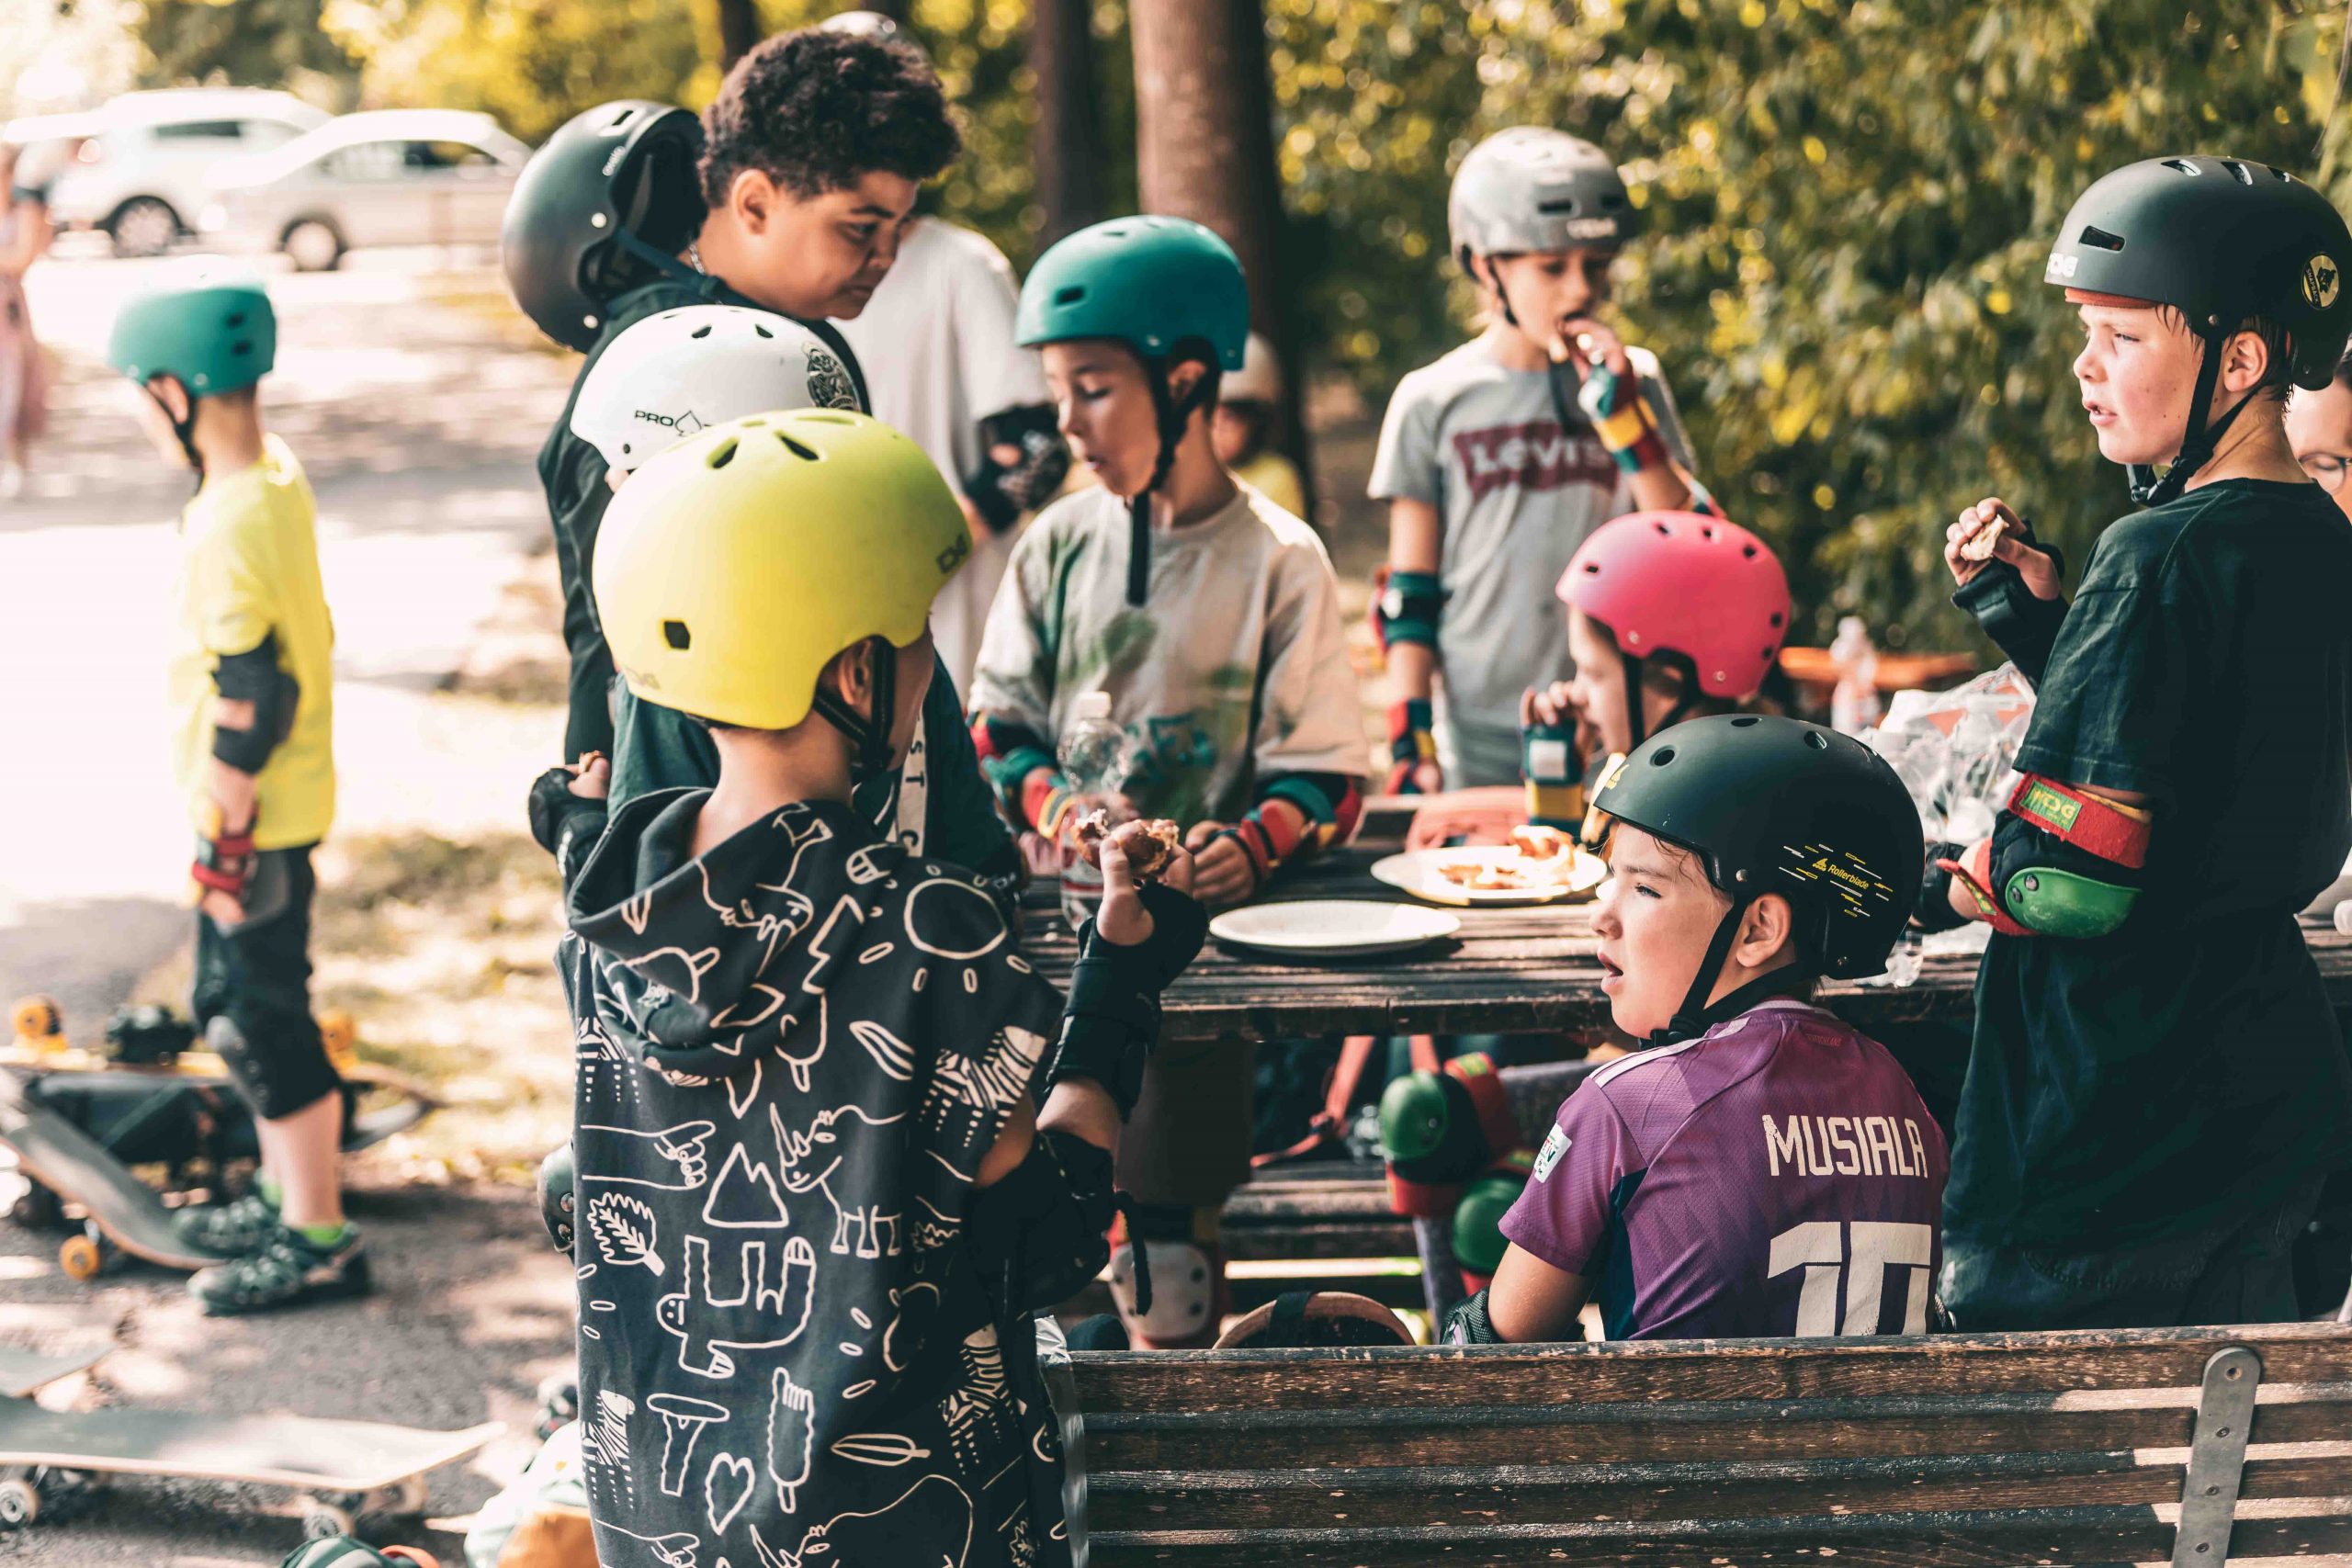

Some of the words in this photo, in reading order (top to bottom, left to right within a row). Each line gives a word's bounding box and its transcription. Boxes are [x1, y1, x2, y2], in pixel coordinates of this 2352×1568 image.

[634, 410, 674, 427] PRO
[1827, 863, 1870, 890] Rollerblade
[1761, 1114, 1928, 1179] MUSIALA
